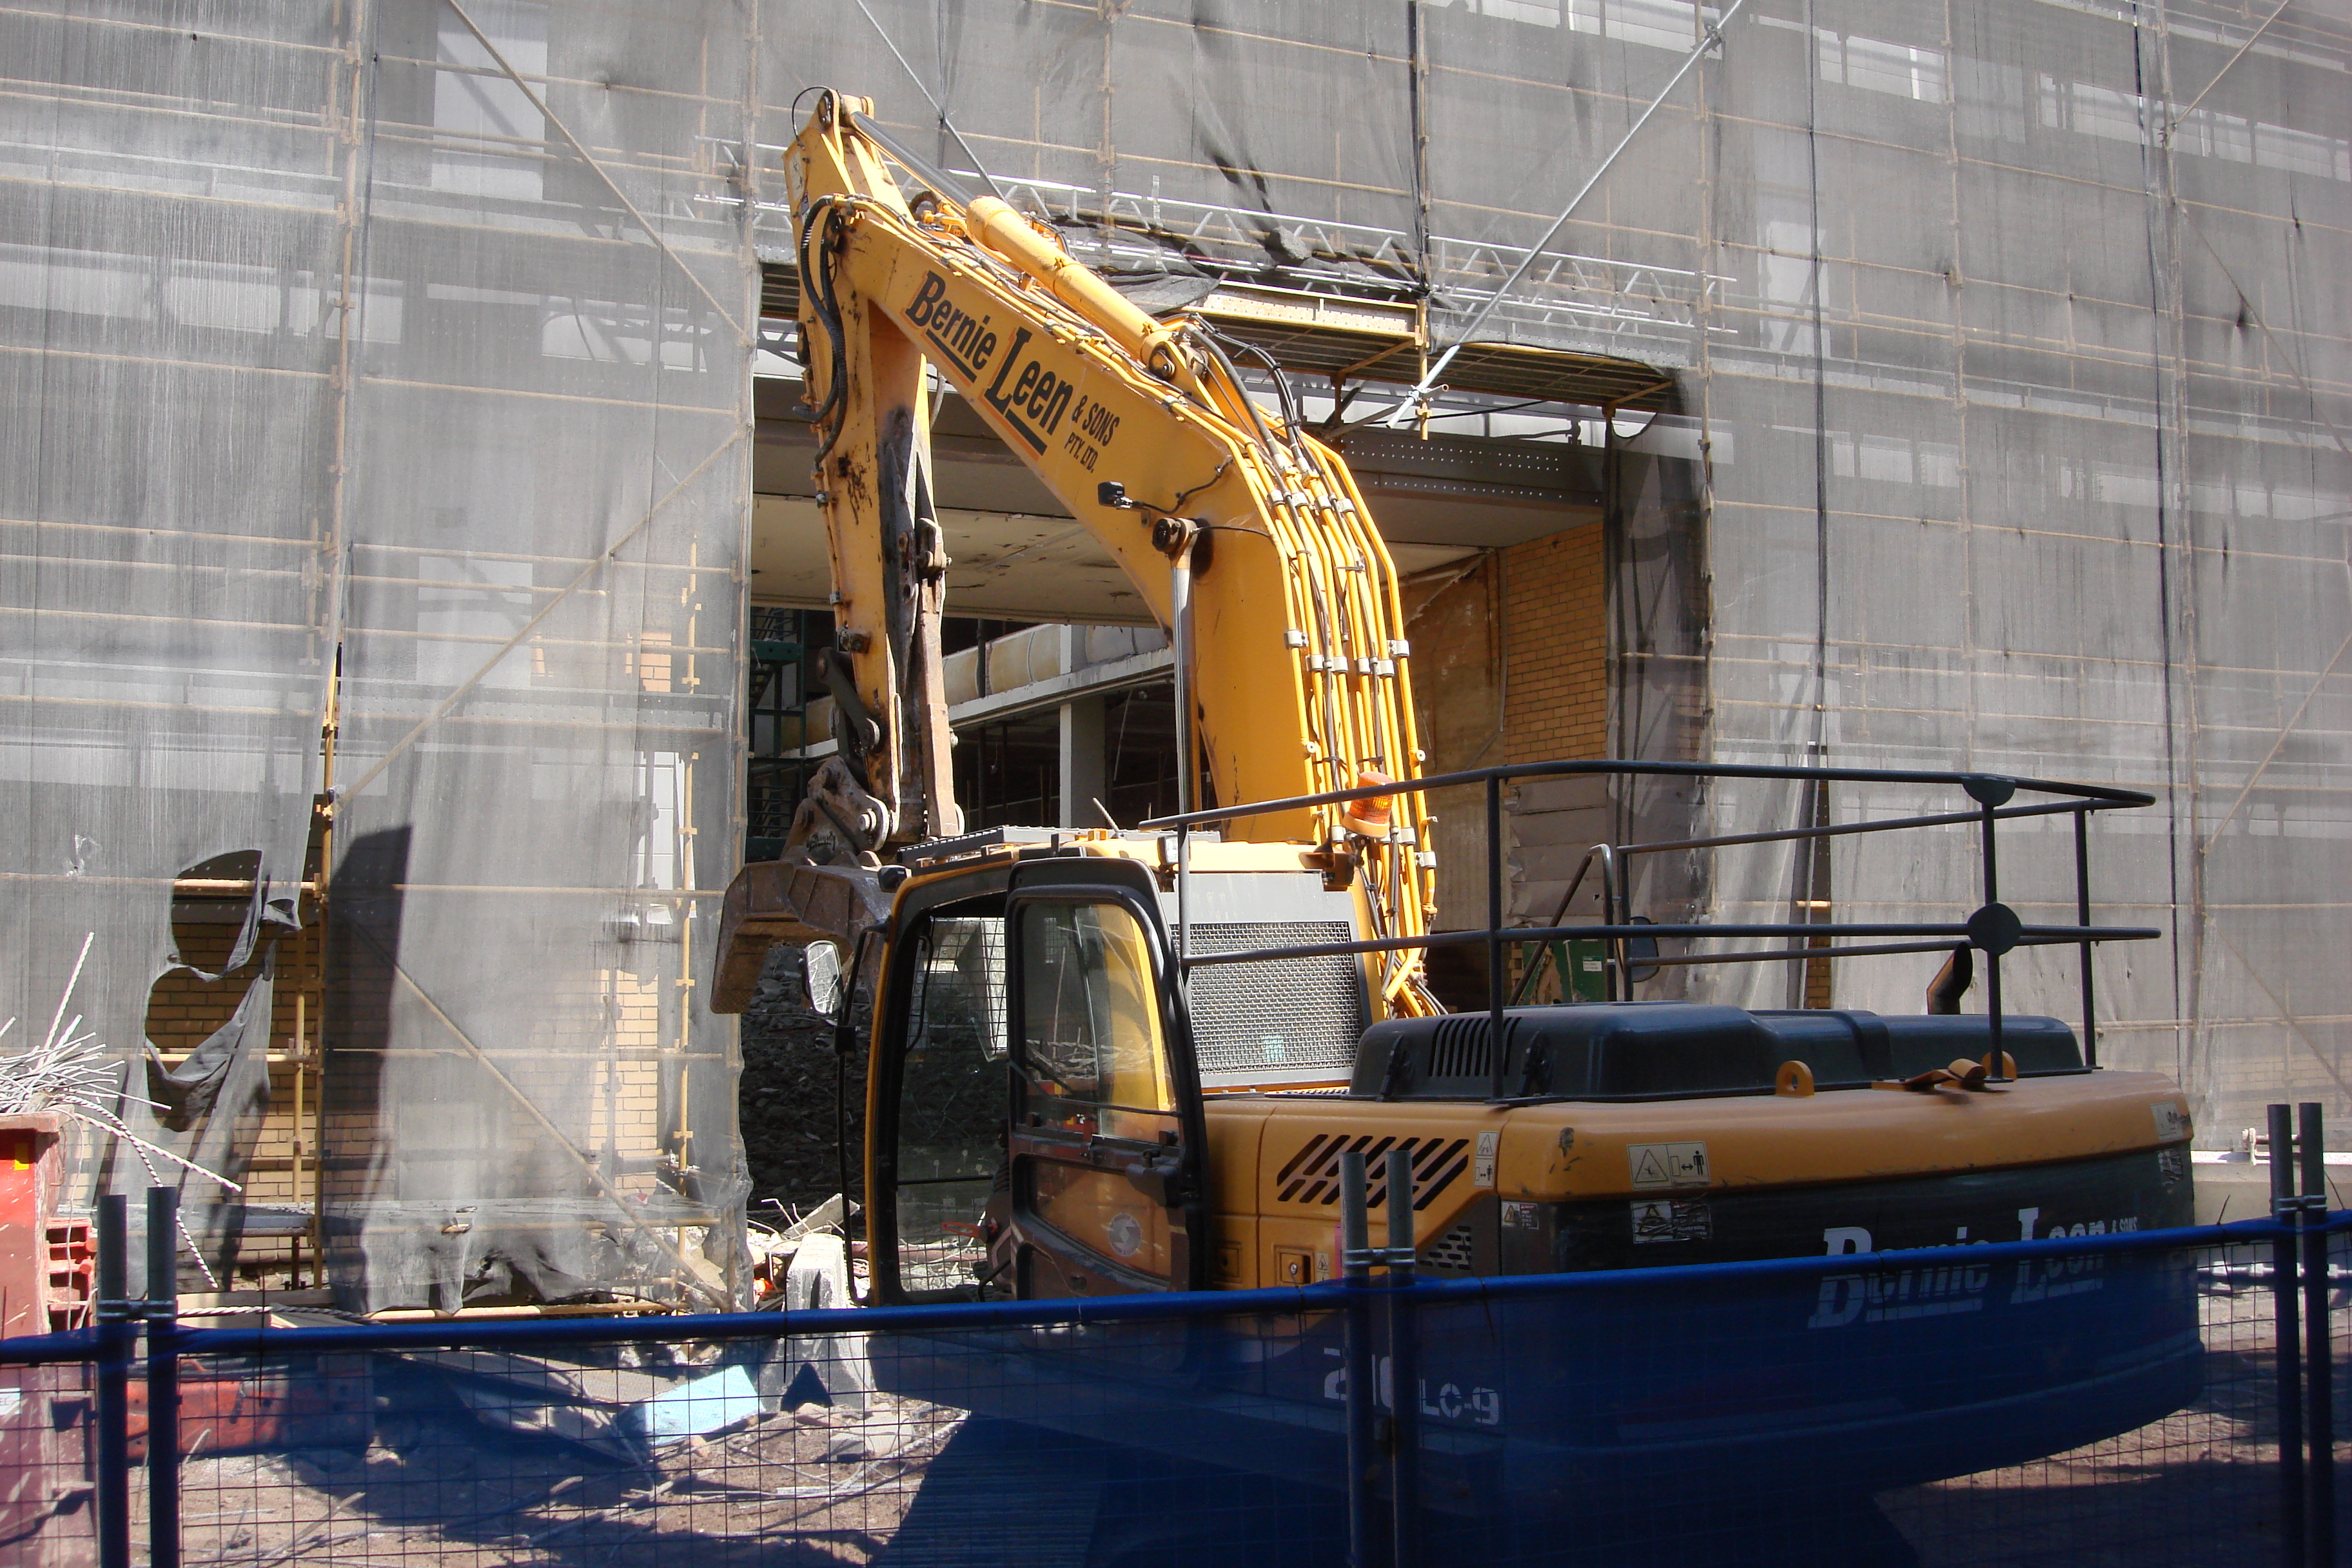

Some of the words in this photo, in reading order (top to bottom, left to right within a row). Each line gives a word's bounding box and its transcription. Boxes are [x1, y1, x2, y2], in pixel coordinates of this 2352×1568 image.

[905, 270, 997, 370] Bernie
[985, 326, 1073, 436] Leen
[1072, 395, 1088, 423] &
[1082, 402, 1120, 447] SONS
